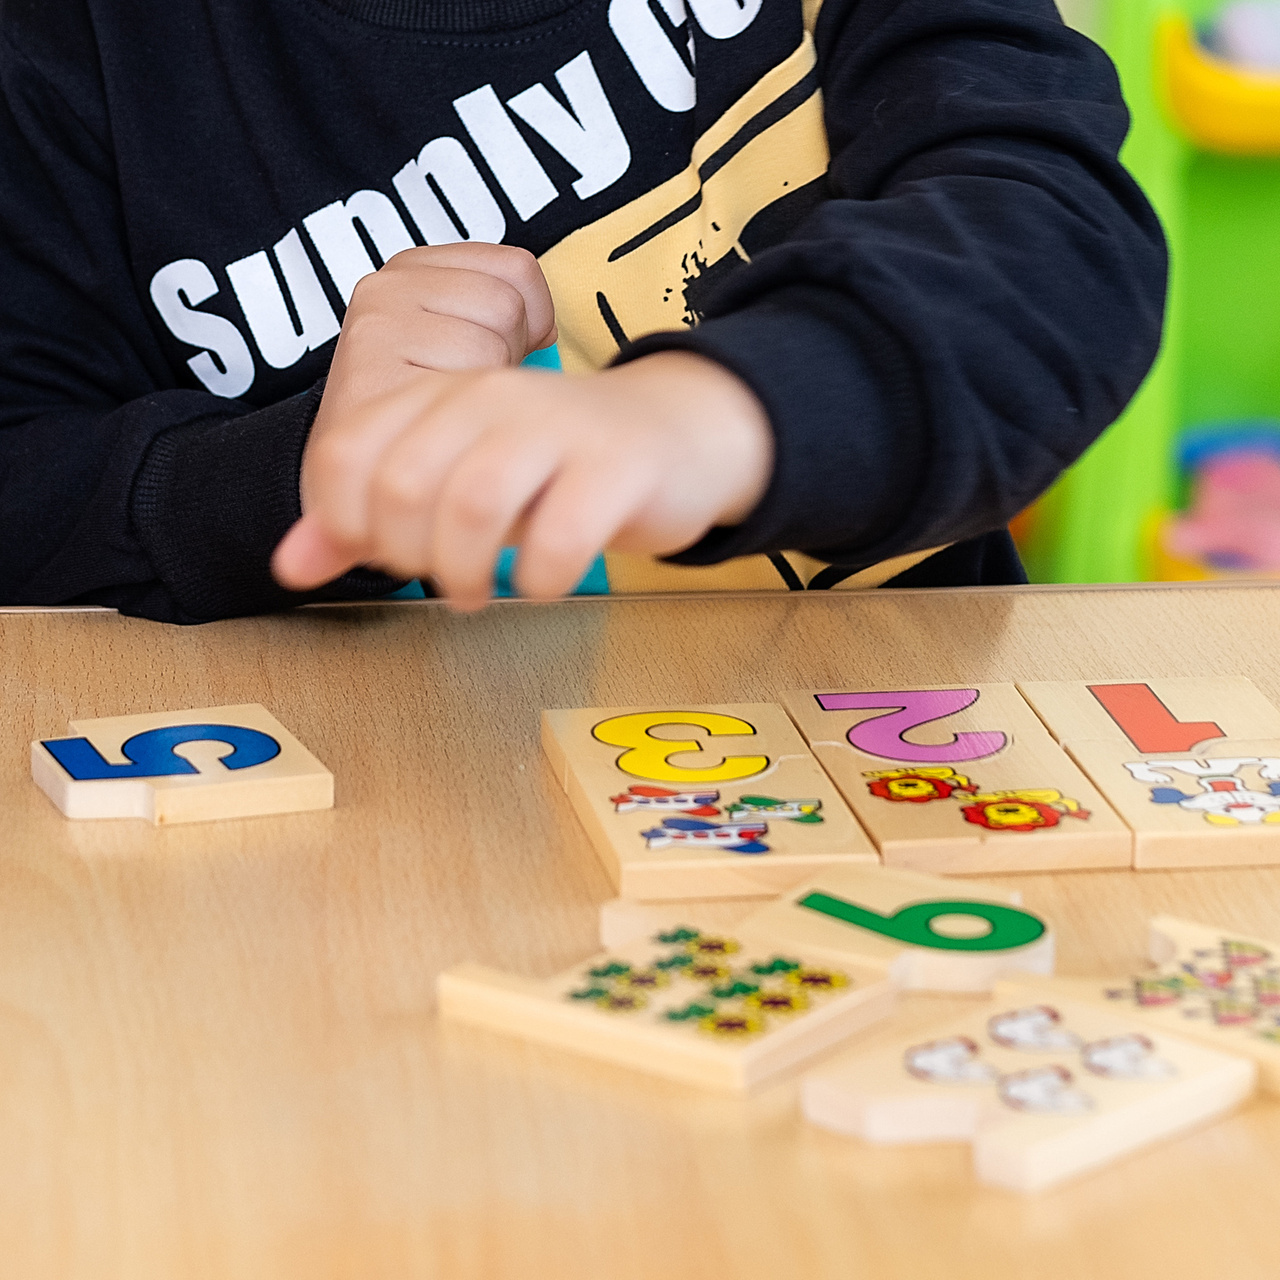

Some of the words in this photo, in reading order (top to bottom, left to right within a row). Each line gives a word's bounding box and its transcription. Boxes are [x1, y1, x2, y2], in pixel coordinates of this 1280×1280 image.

[40, 723, 282, 781] 5
[592, 710, 771, 783] 3
[813, 688, 1007, 762] 2
[1086, 683, 1227, 754] 1
